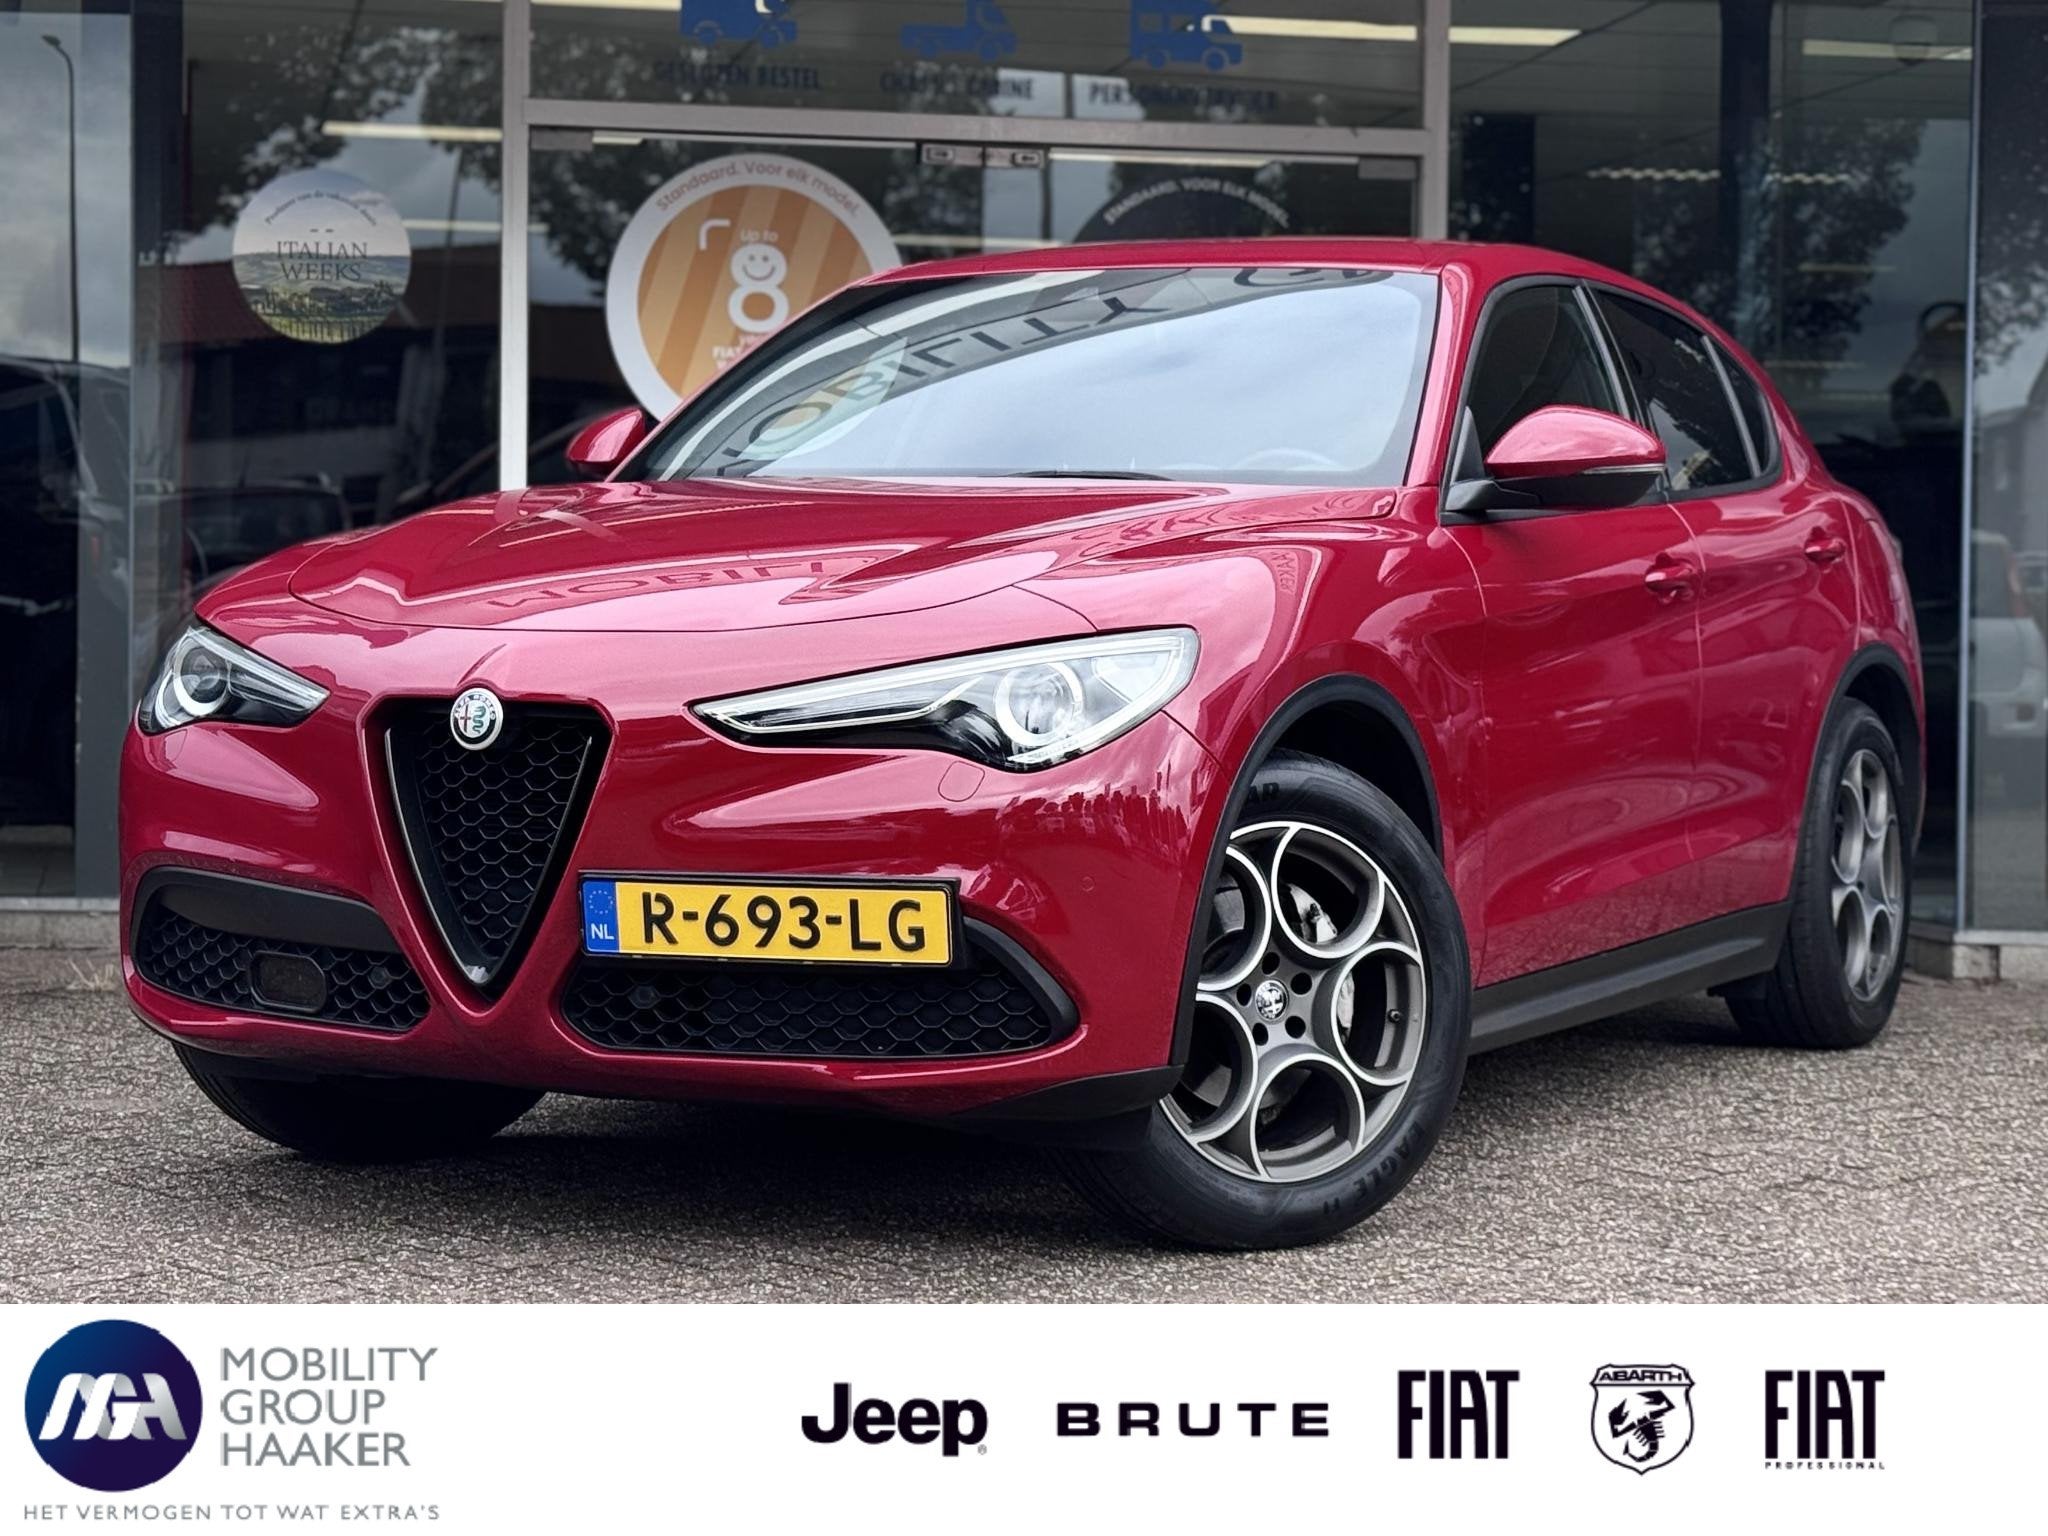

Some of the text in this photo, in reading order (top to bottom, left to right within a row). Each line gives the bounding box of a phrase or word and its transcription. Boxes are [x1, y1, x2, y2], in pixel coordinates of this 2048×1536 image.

[744, 161, 782, 176] Voor
[786, 164, 808, 182] elk
[1180, 177, 1222, 192] VOOR
[763, 230, 778, 242] to
[276, 240, 369, 260] ITALIAN
[280, 263, 362, 282] WEEKS
[590, 922, 614, 940] NL
[641, 891, 926, 952] R-693-LG
